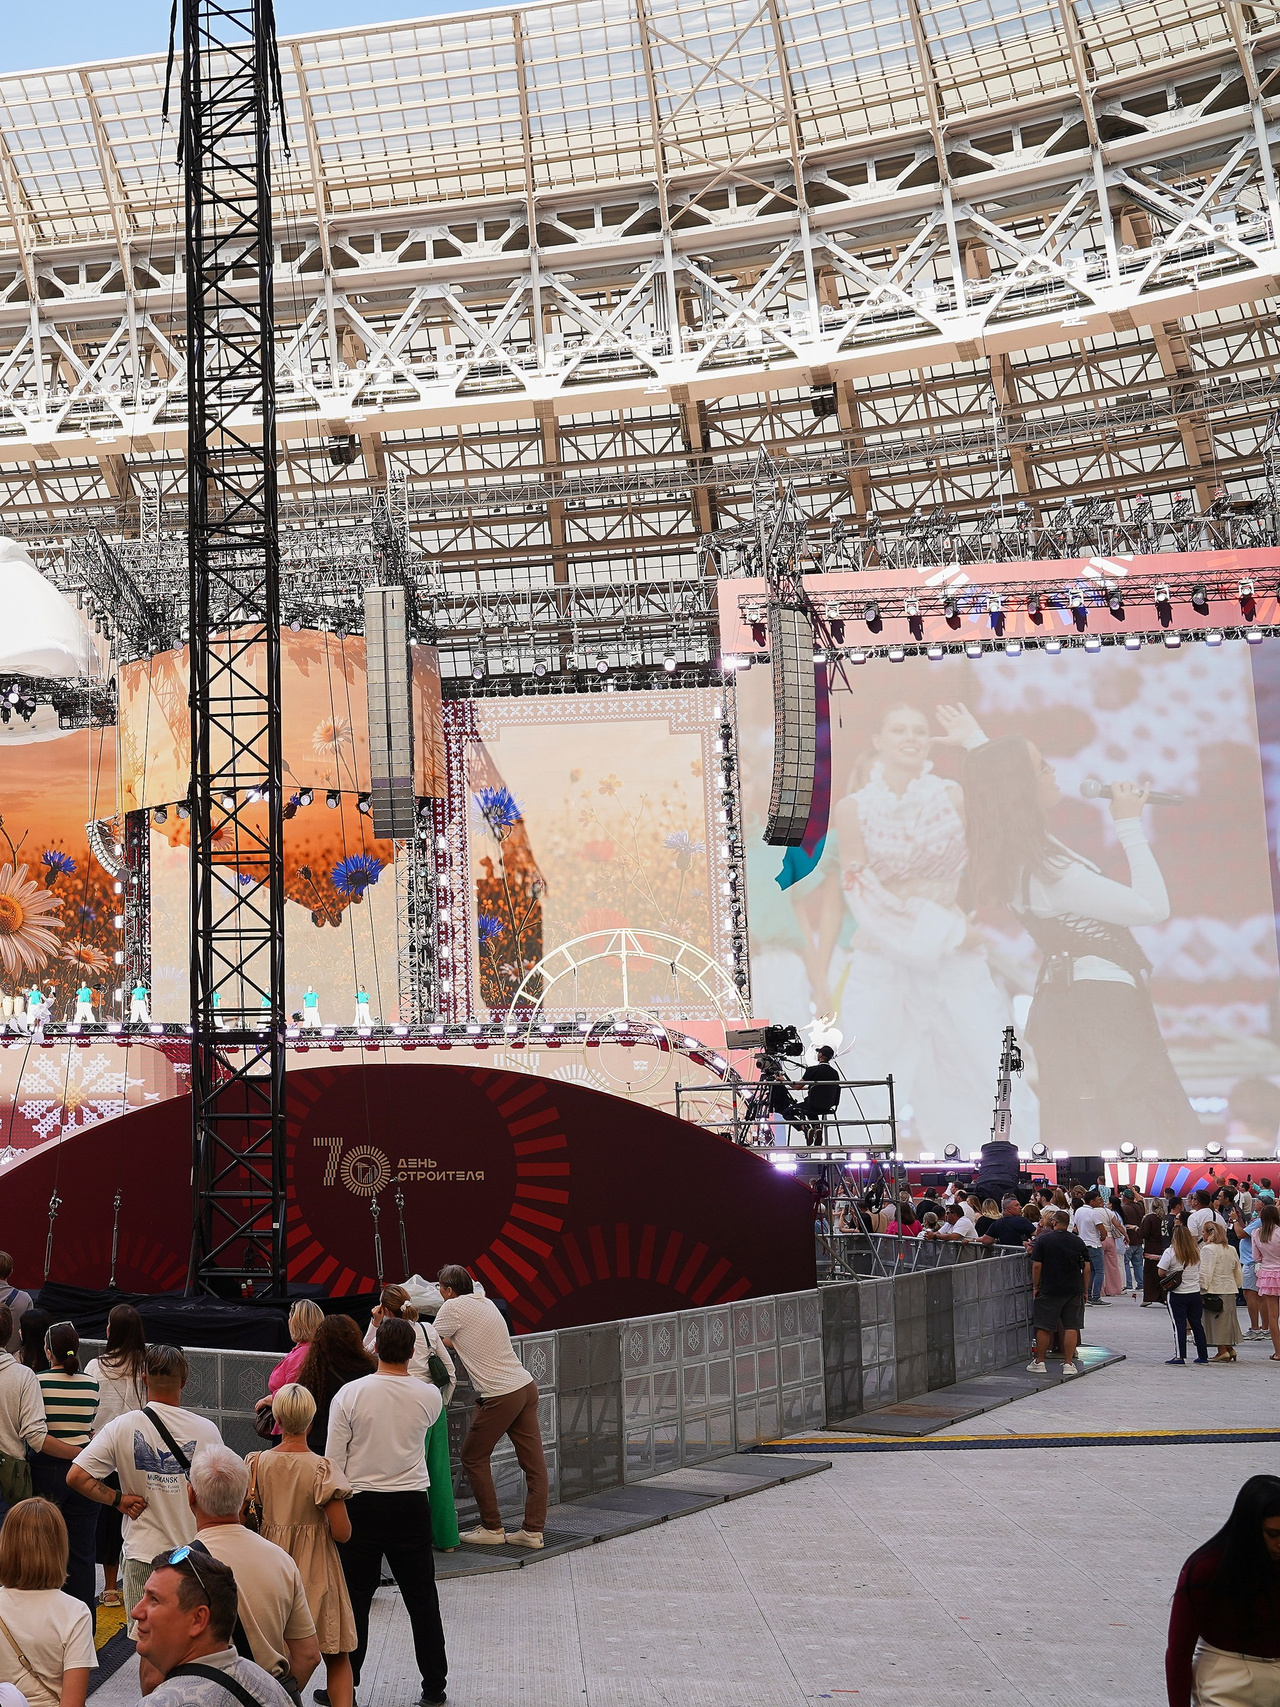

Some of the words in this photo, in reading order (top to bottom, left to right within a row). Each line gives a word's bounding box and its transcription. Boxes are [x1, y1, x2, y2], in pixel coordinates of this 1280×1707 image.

[313, 1137, 391, 1197] 70
[397, 1158, 438, 1168] ДЕНЬ
[397, 1171, 485, 1181] СТРОИТЕЛЯ
[147, 1474, 178, 1483] MURMANSK
